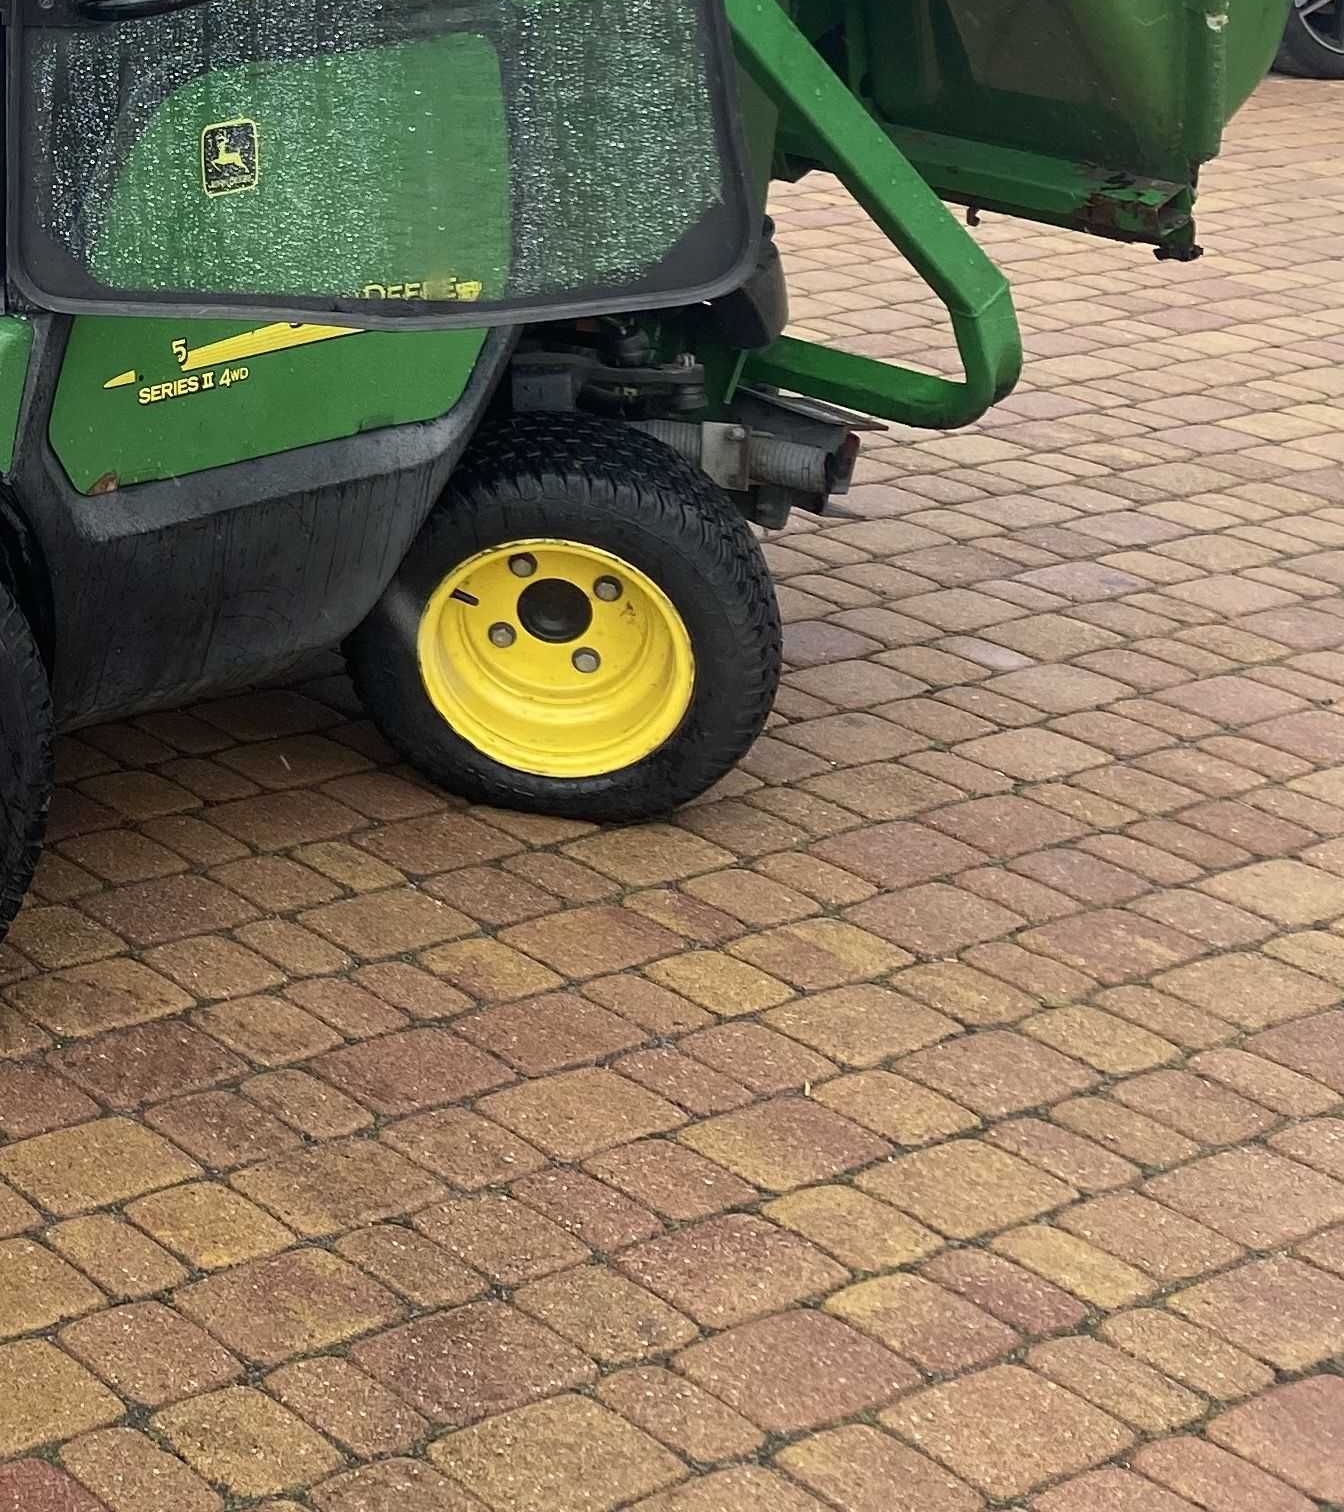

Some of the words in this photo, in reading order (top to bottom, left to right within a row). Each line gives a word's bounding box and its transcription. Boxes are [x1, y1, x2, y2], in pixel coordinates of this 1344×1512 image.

[171, 338, 188, 363] 5
[138, 375, 200, 405] SERIES
[202, 371, 214, 389] II
[218, 367, 249, 388] 4WD
